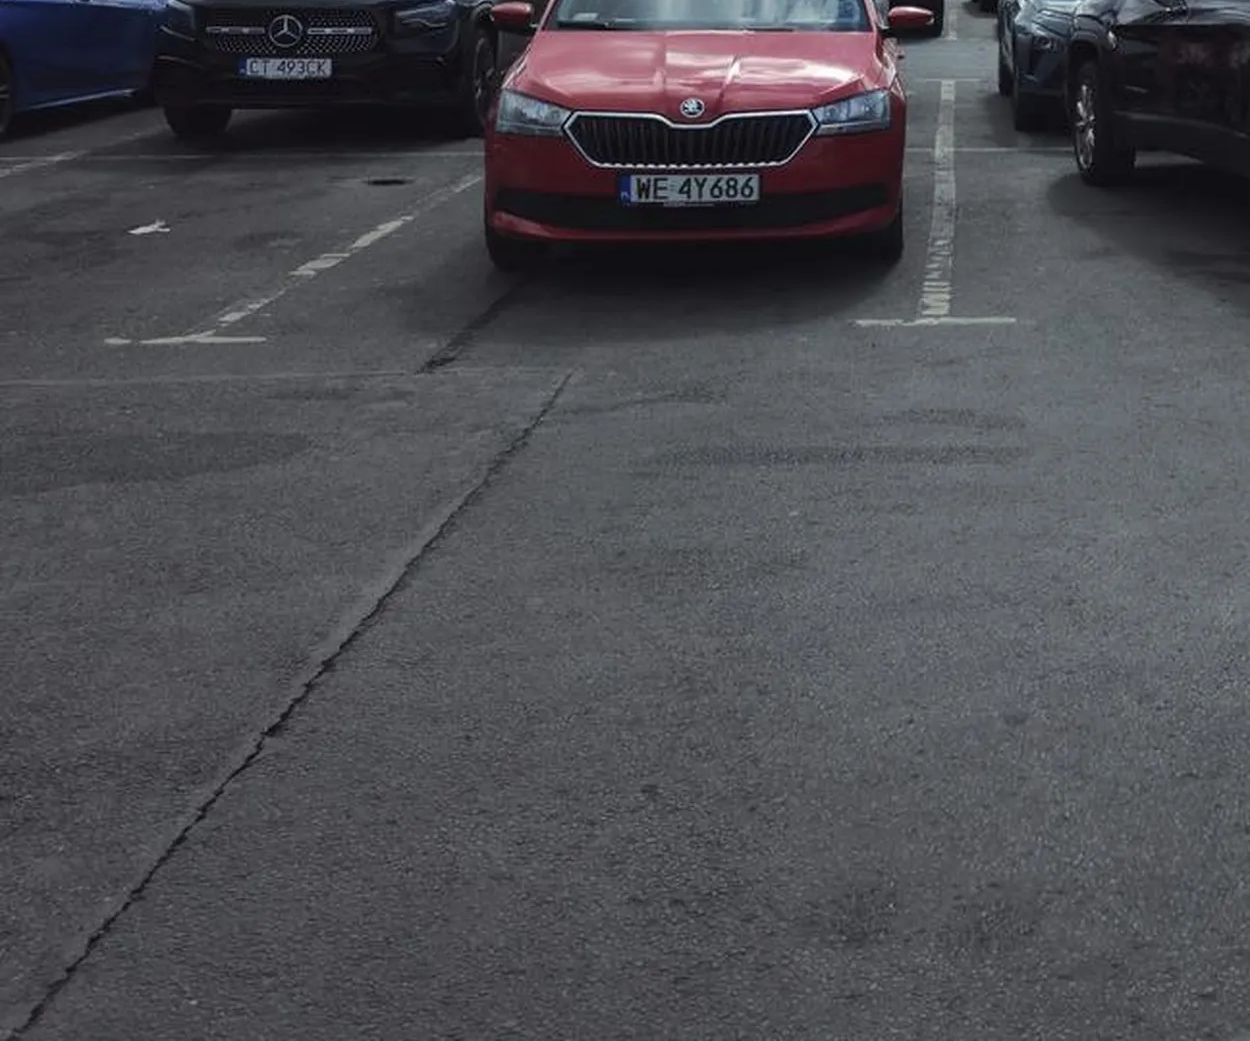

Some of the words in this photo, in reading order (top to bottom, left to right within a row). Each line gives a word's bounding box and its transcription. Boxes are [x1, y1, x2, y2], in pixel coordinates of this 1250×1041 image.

[250, 61, 270, 74] CT
[636, 177, 669, 200] WE
[678, 177, 754, 199] 4Y686
